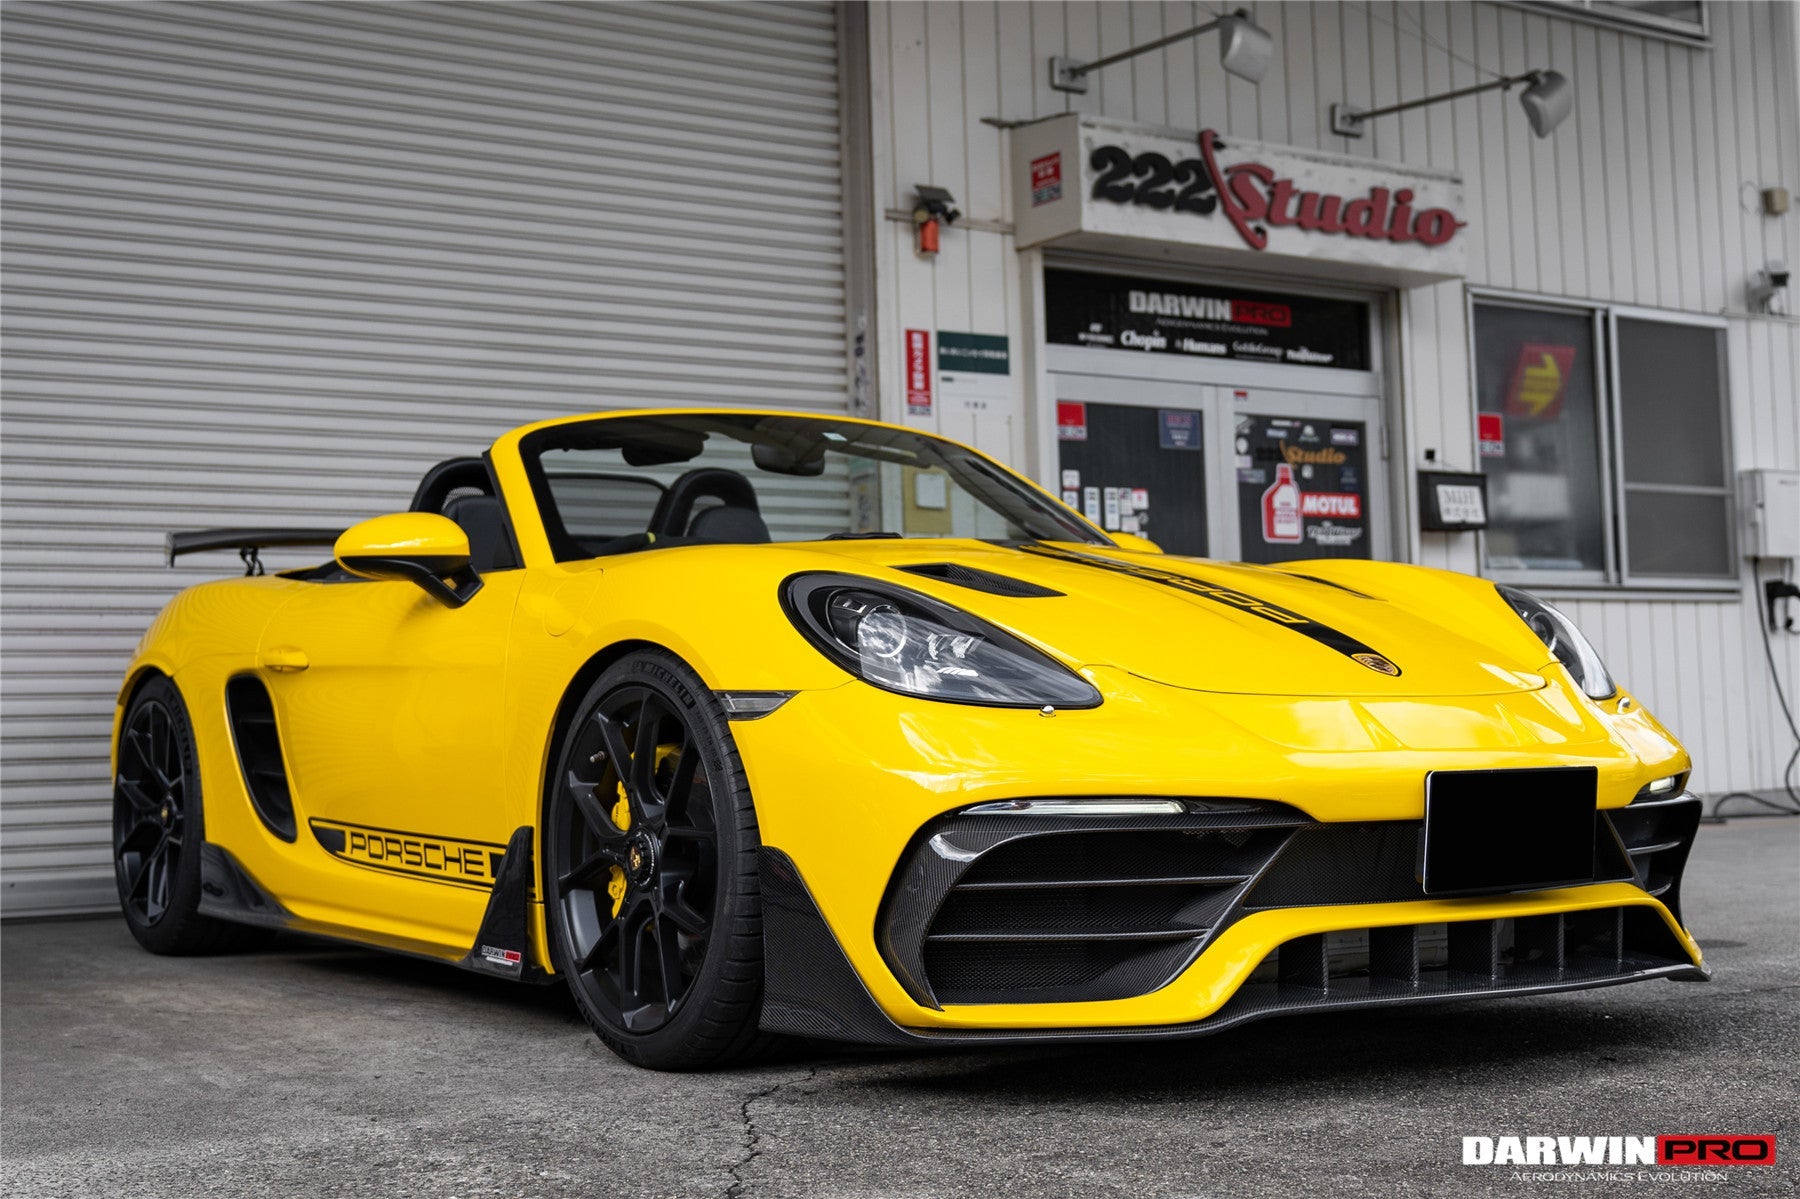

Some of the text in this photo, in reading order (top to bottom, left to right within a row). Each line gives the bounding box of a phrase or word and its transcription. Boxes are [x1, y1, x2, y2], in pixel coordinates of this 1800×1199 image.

[1090, 145, 1217, 215] 222
[1225, 162, 1467, 246] Studio
[1129, 290, 1287, 323] DARWIN PRO
[1120, 328, 1167, 351] Chopin
[1285, 446, 1347, 465] Studio
[1303, 495, 1359, 516] MOTUL
[644, 662, 695, 709] MICHELIN
[350, 831, 485, 876] PORSCHE
